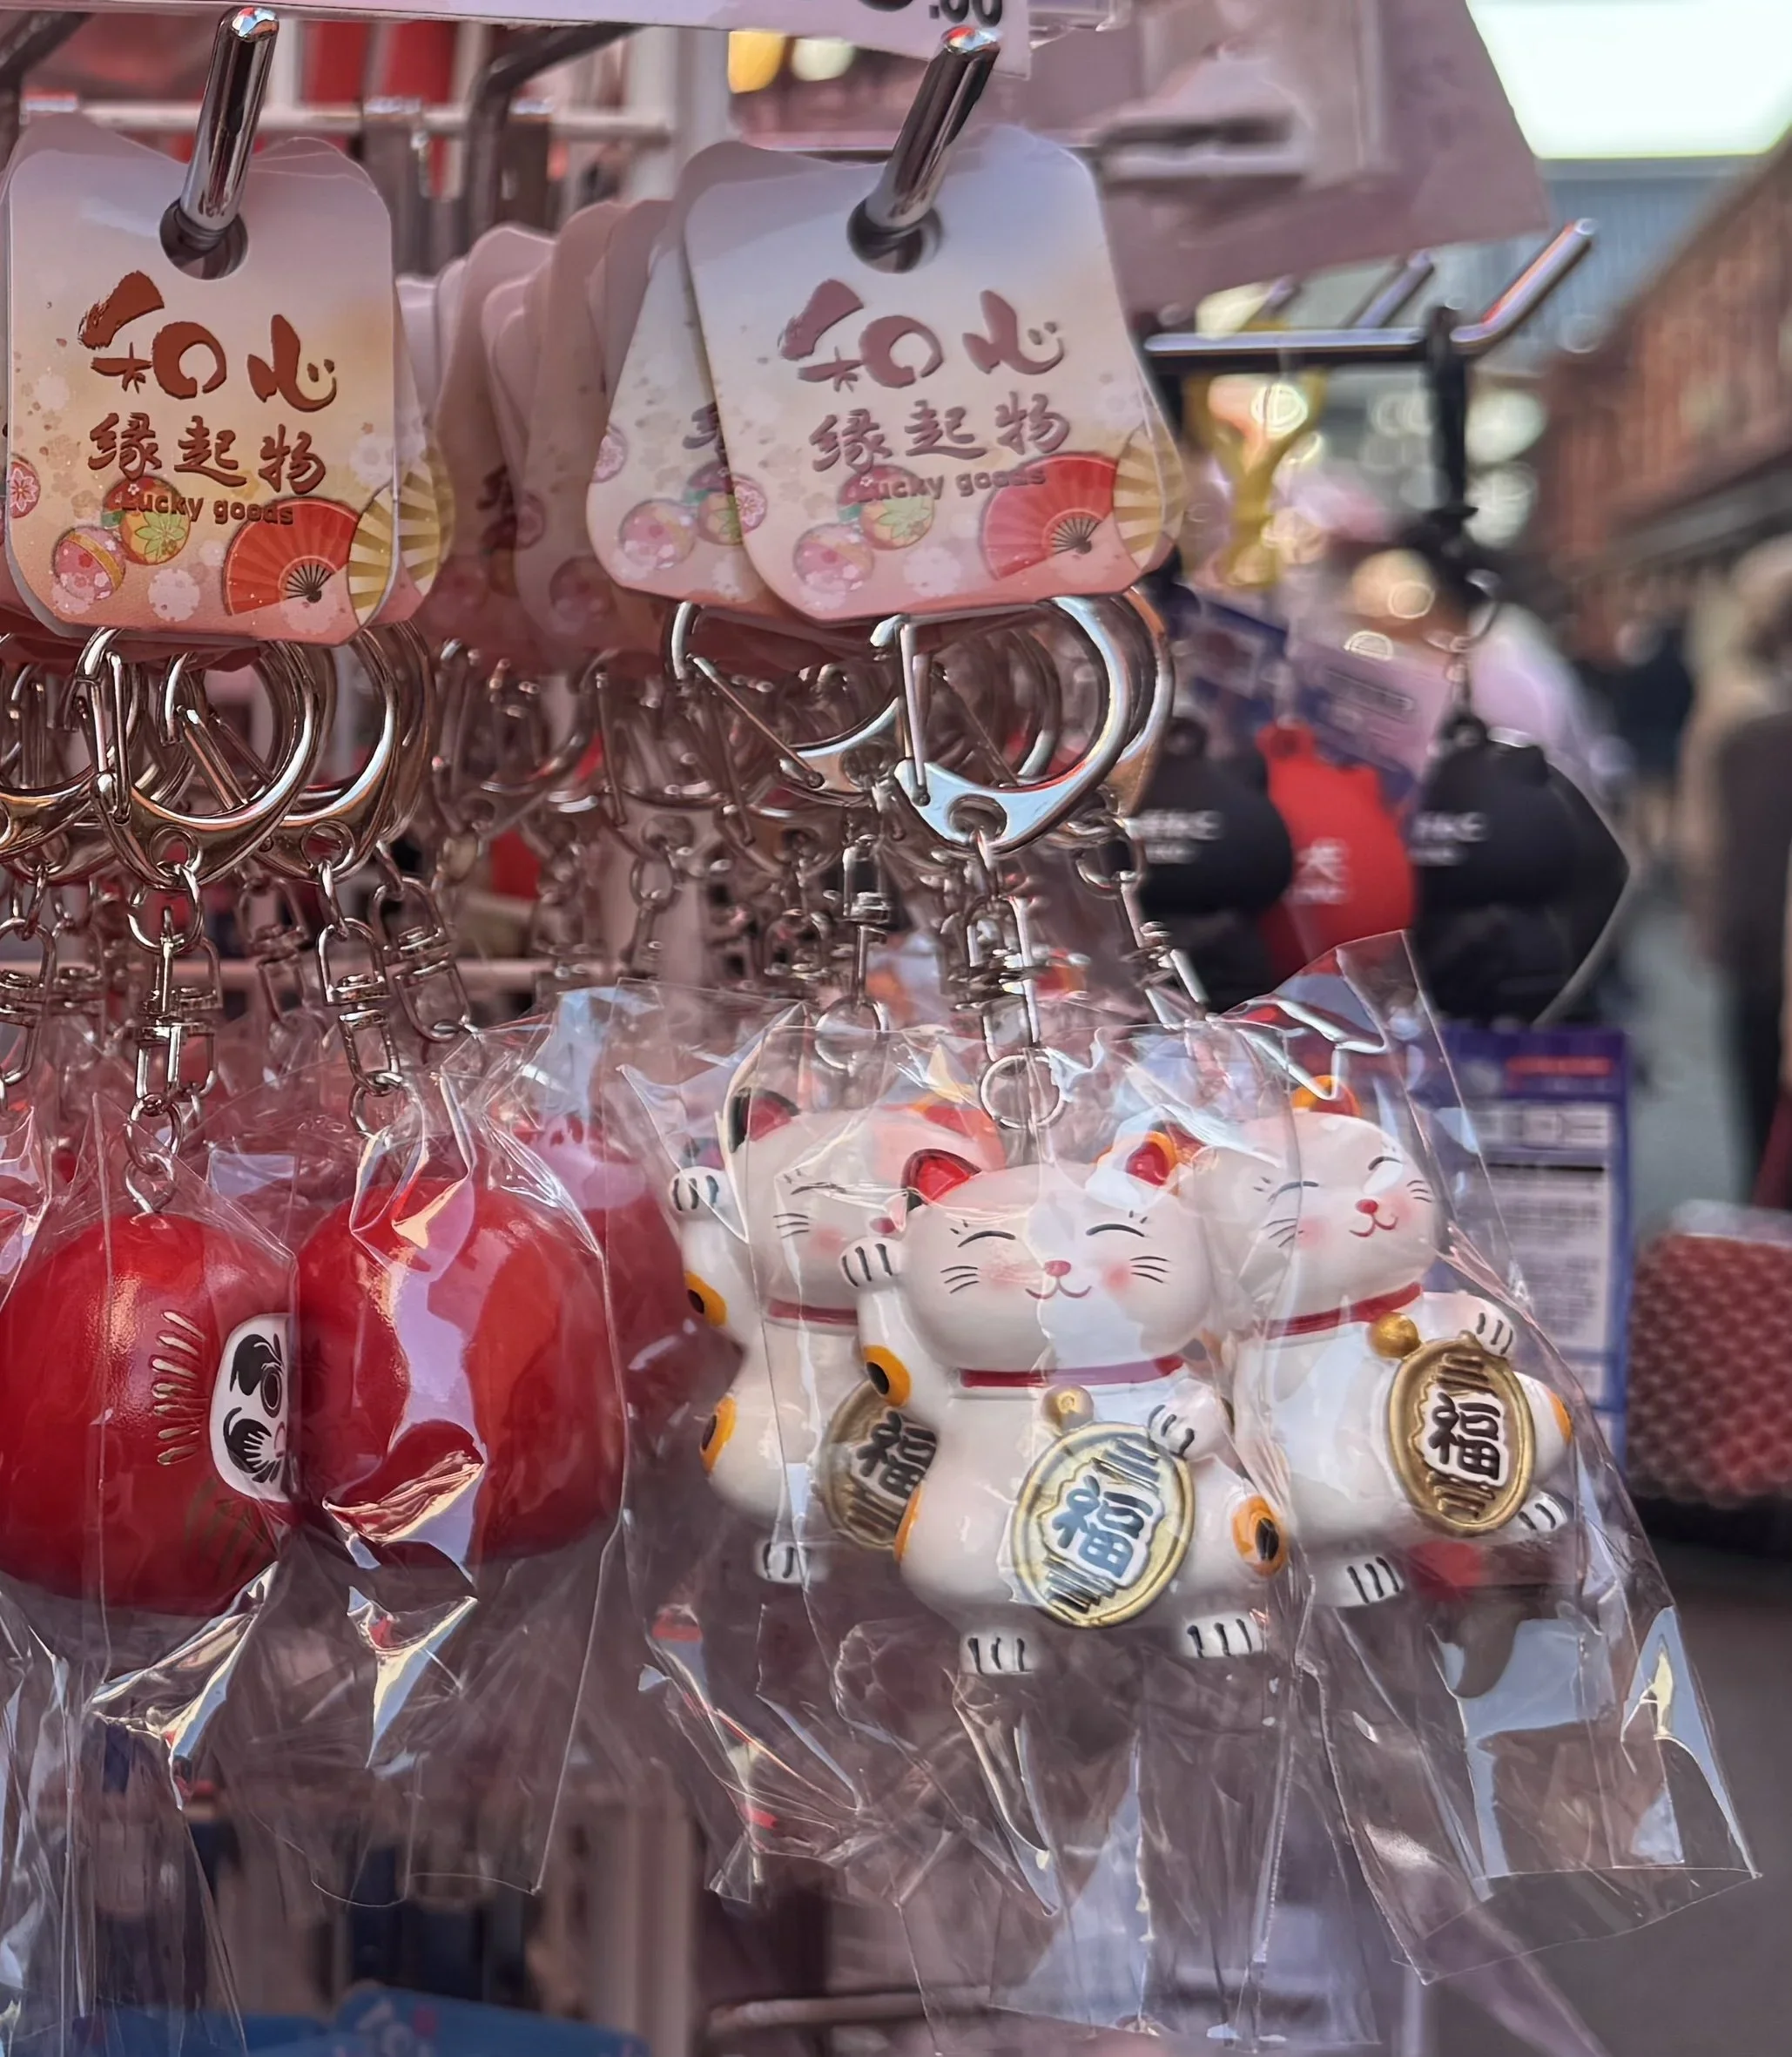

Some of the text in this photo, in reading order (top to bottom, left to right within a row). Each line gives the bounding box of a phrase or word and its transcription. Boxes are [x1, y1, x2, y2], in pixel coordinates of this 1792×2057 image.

[87, 412, 327, 495] 縁起物
[809, 391, 1070, 474] 縁起物
[122, 489, 294, 525] Lucky goods
[955, 468, 1047, 498] goods
[856, 1410, 937, 1499] 福
[1428, 1392, 1501, 1480] 福
[1053, 1474, 1154, 1579] 福
